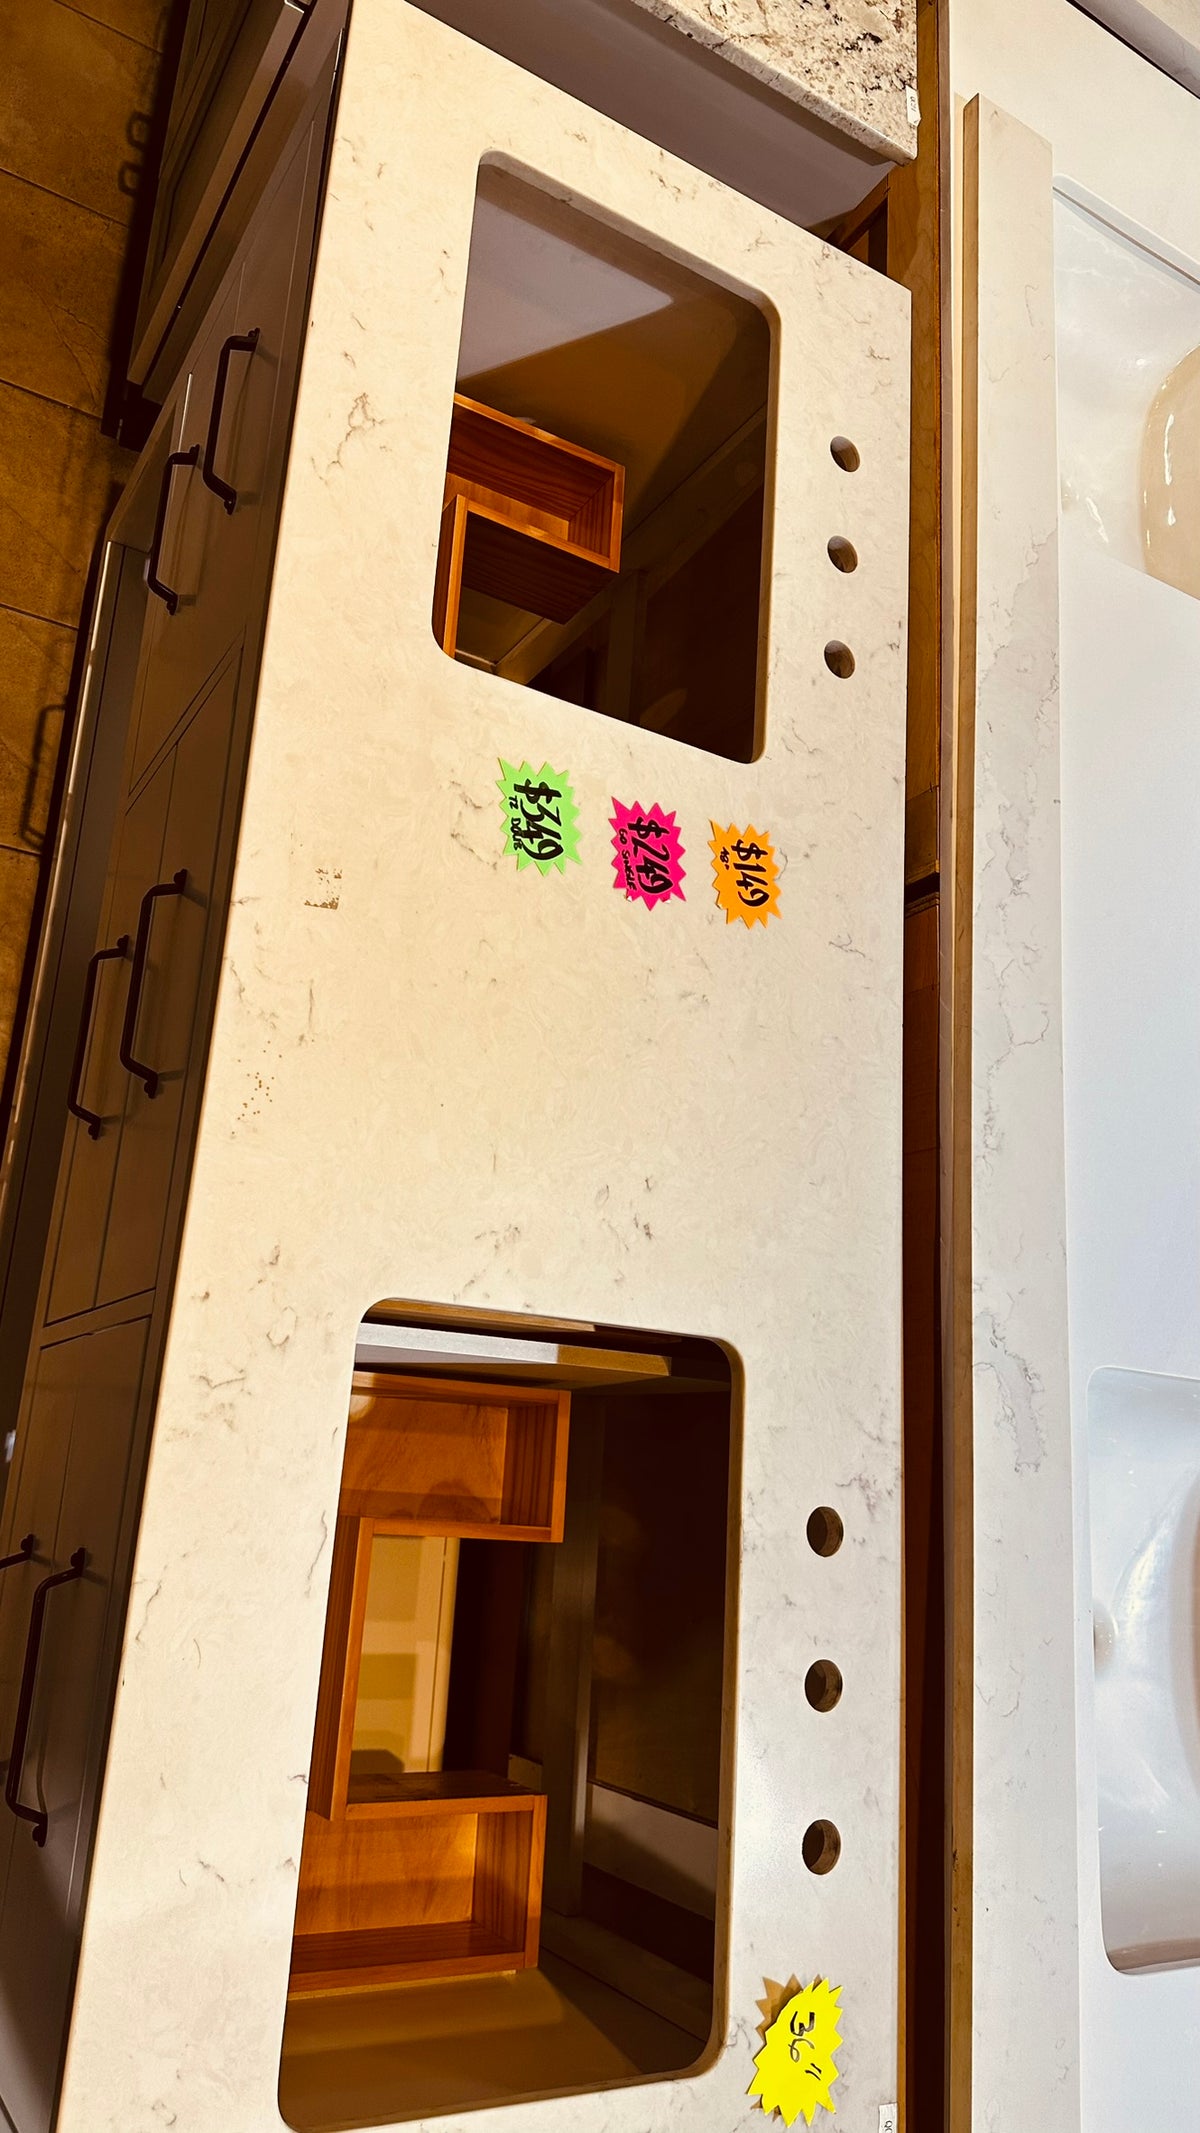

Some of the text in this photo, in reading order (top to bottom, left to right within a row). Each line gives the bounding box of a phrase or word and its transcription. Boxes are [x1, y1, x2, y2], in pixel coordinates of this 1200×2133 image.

[514, 778, 564, 860] $349
[627, 816, 674, 894] $249
[730, 838, 770, 907] $149
